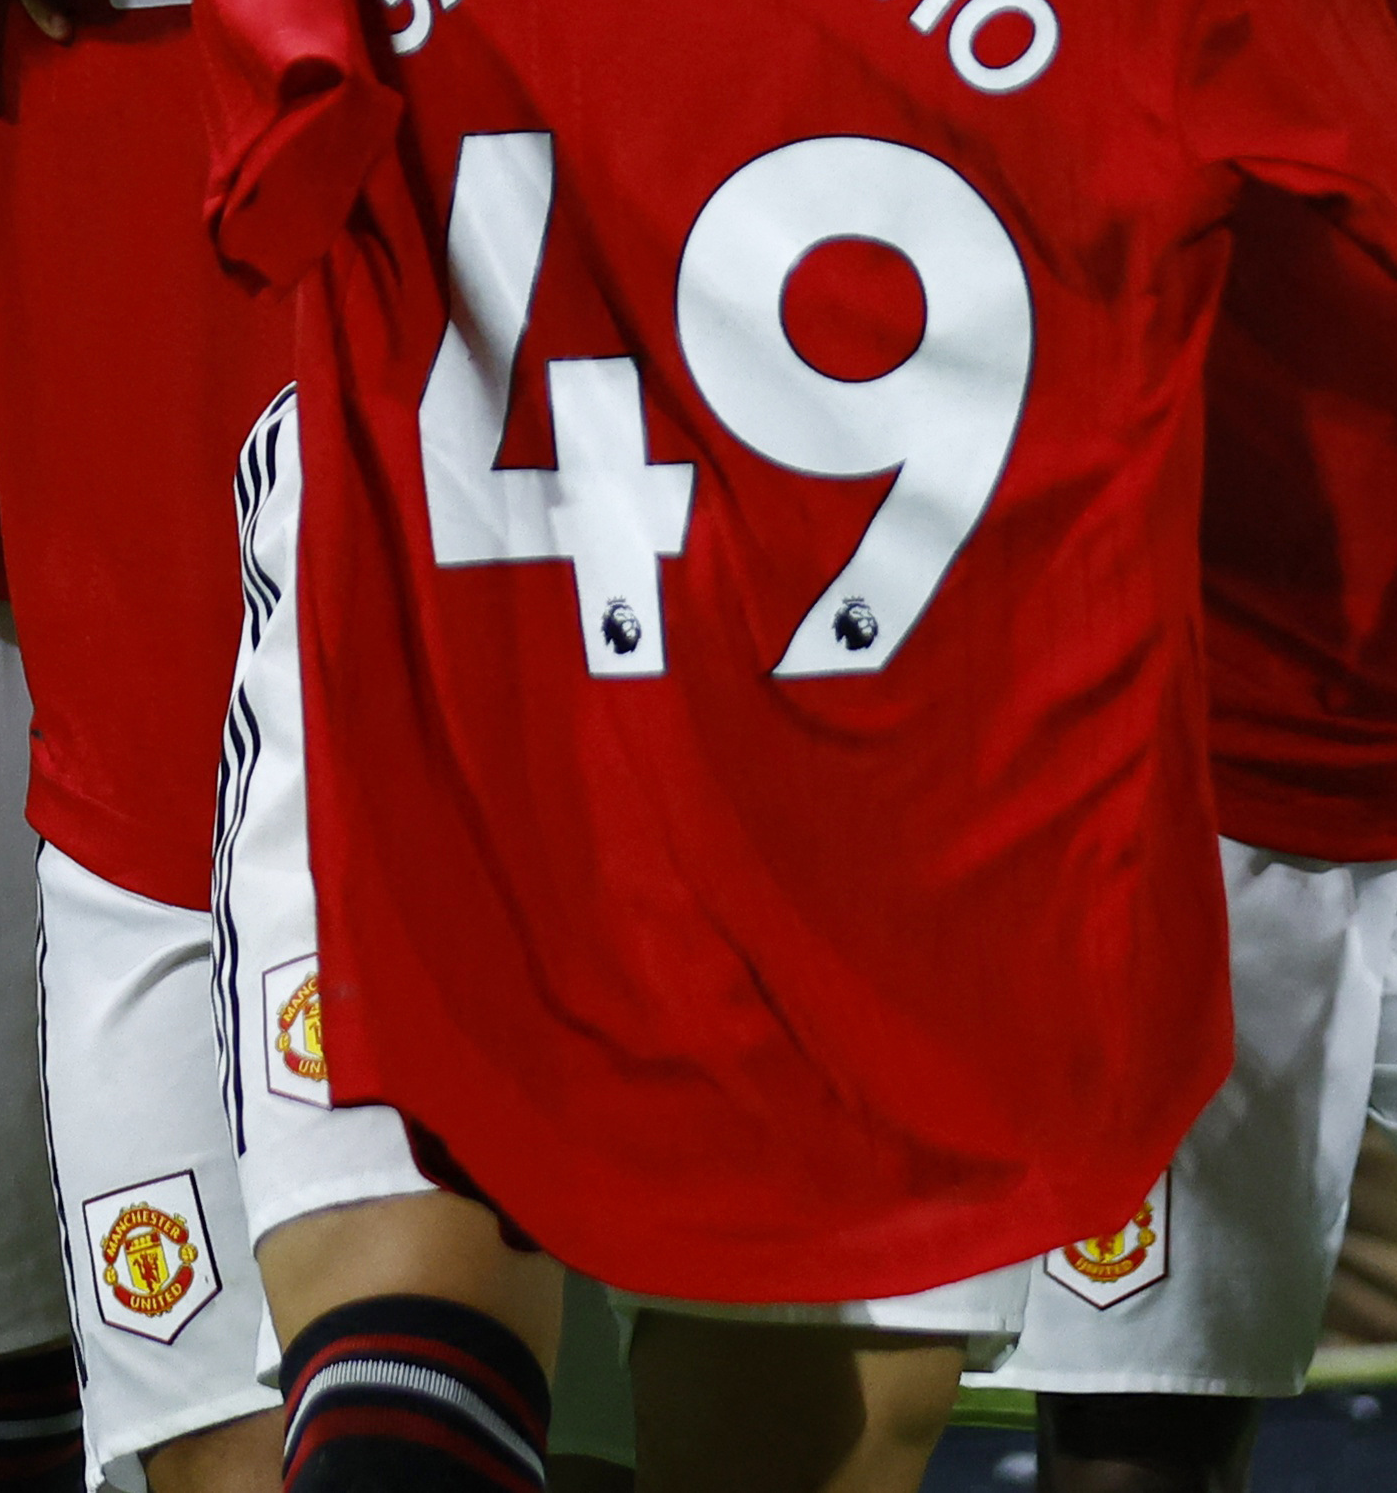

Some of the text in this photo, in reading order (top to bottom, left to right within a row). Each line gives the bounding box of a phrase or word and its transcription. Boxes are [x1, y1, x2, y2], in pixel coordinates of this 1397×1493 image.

[418, 129, 1035, 679] 49
[106, 1209, 181, 1257] MANCHESTER
[129, 1282, 184, 1311] UNITED
